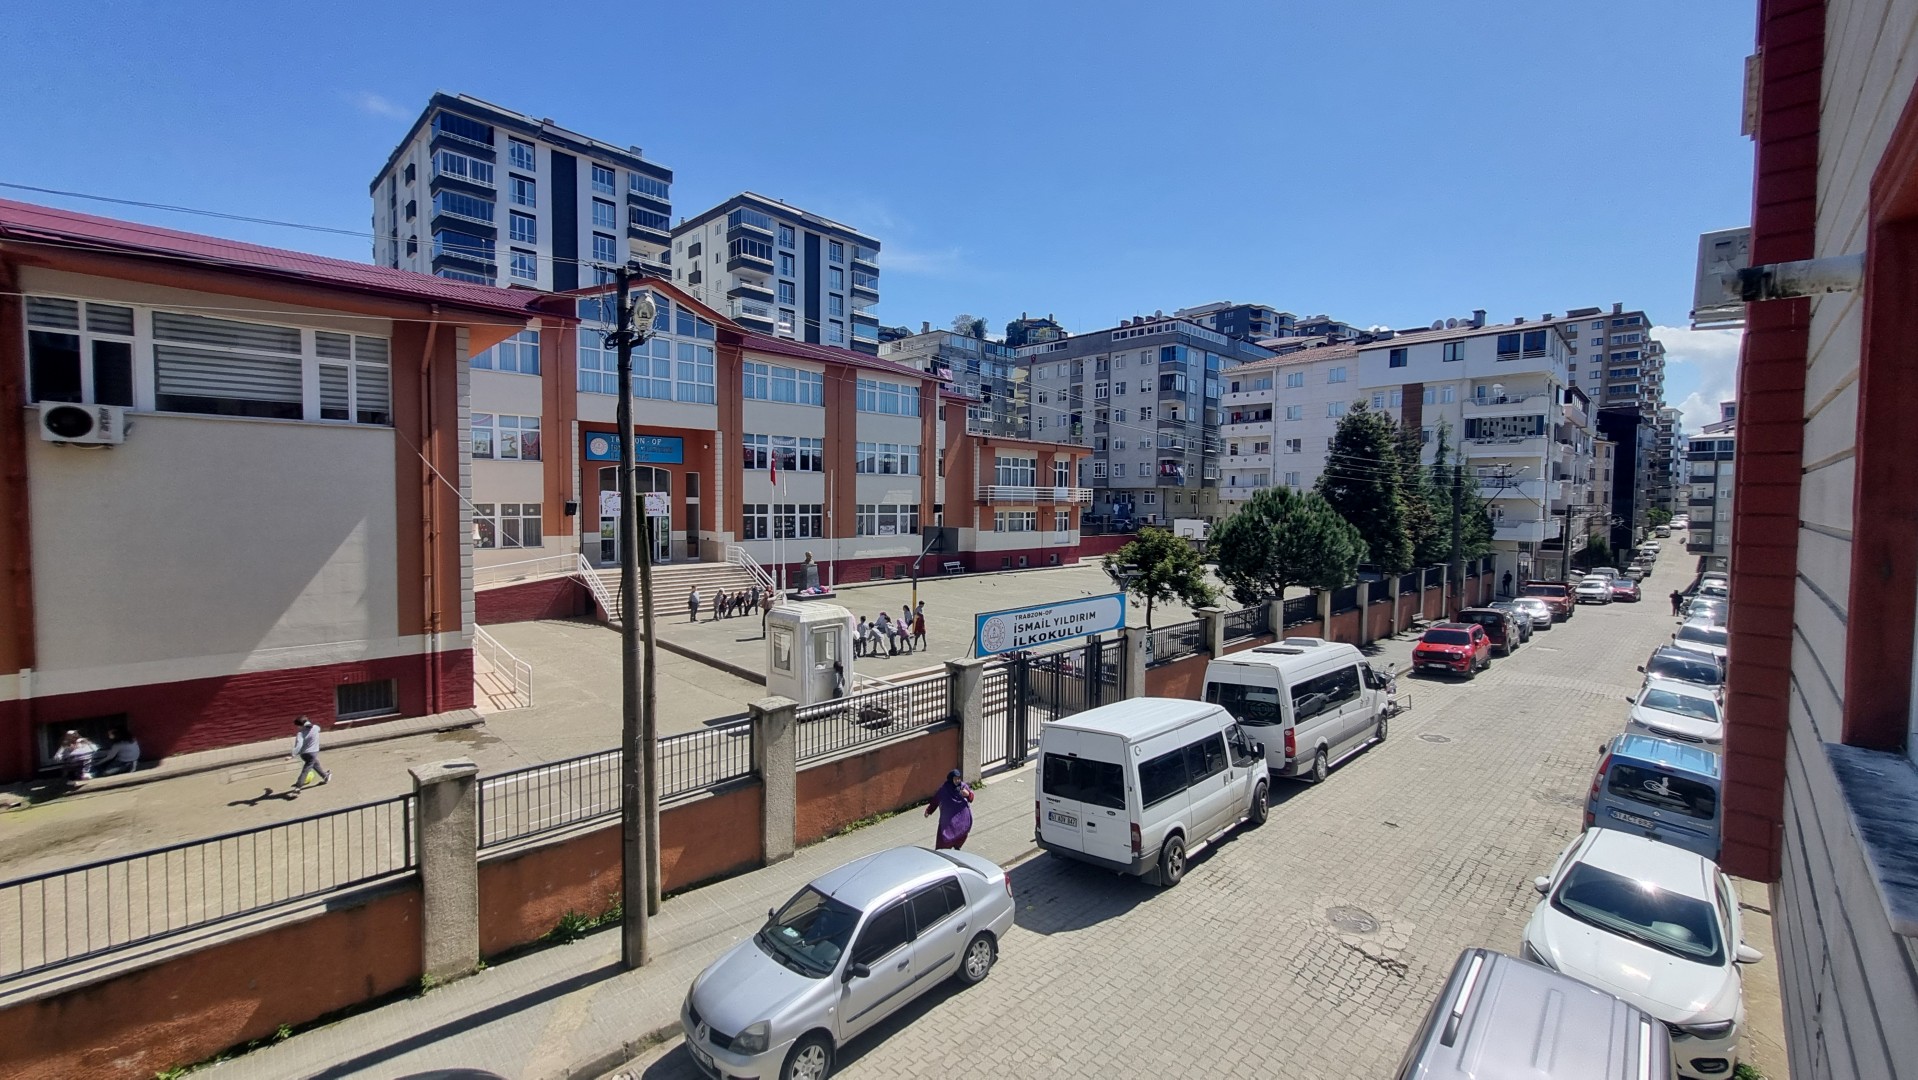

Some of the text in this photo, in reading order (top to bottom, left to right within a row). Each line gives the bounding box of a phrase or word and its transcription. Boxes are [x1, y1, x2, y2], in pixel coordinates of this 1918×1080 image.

[1013, 618, 1051, 634] İSMAİL
[1053, 611, 1096, 627] YILDIRIM
[1015, 609, 1053, 620] TRABZON-OF
[1013, 625, 1083, 646] İLKOKULU
